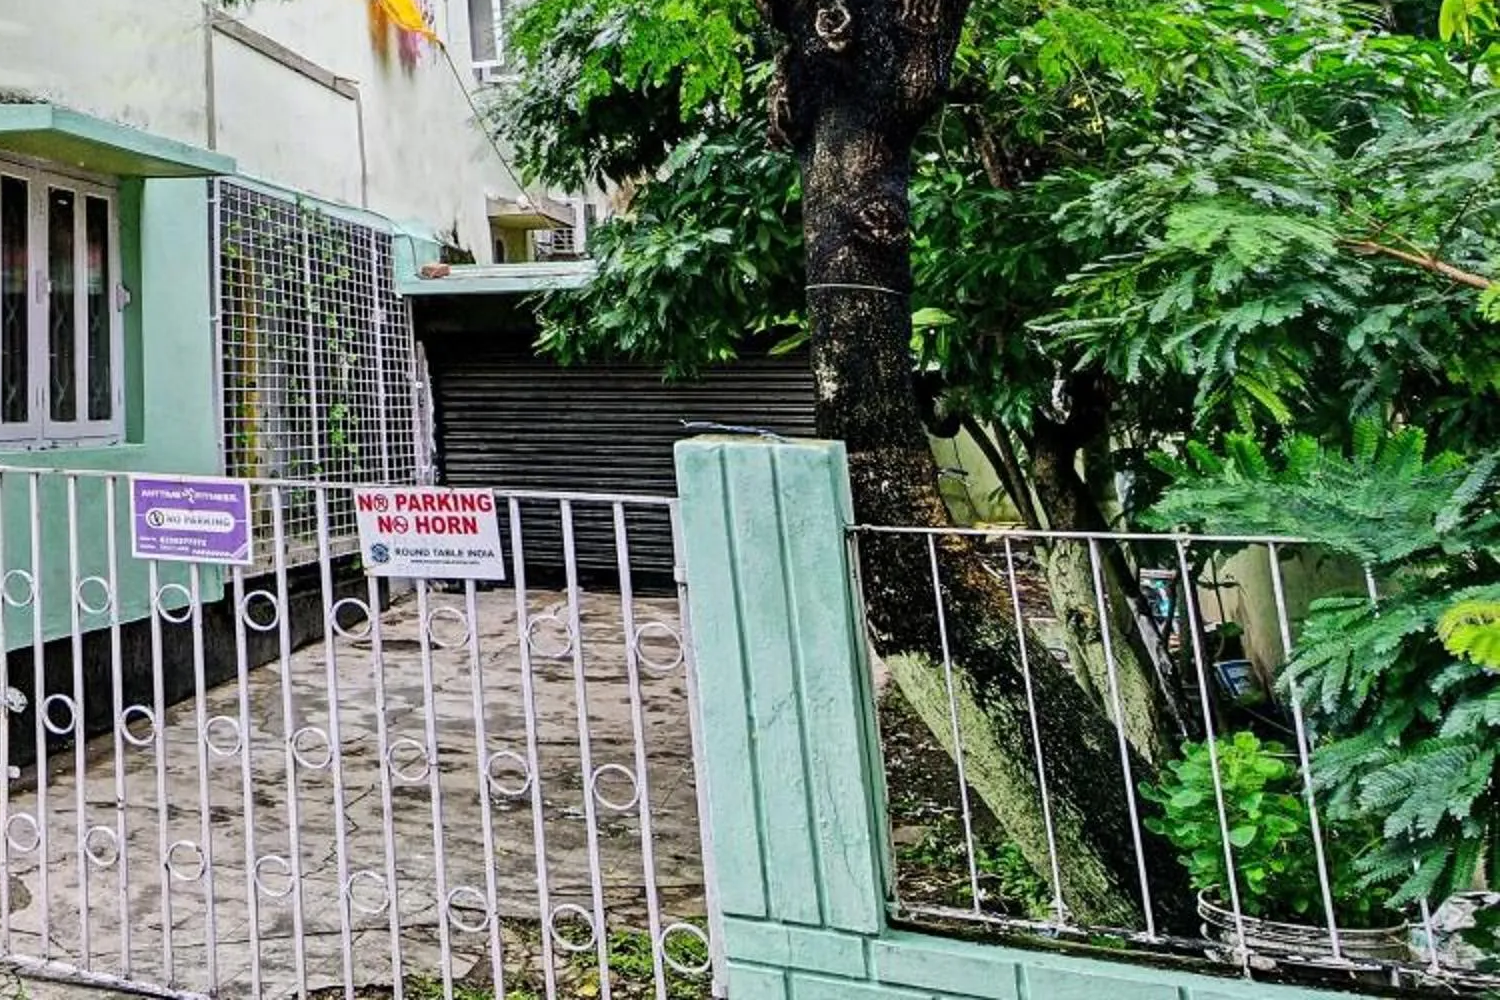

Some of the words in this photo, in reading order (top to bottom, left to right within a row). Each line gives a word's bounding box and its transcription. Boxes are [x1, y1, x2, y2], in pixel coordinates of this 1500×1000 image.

[357, 493, 389, 513] NO
[395, 493, 493, 513] PARKING
[166, 515, 181, 525] NO
[184, 516, 231, 528] PARKING
[377, 515, 409, 535] NO
[415, 515, 479, 535] HORN
[395, 547, 430, 558] ROUND
[433, 548, 464, 558] TABLE
[467, 548, 496, 559] INDIA
